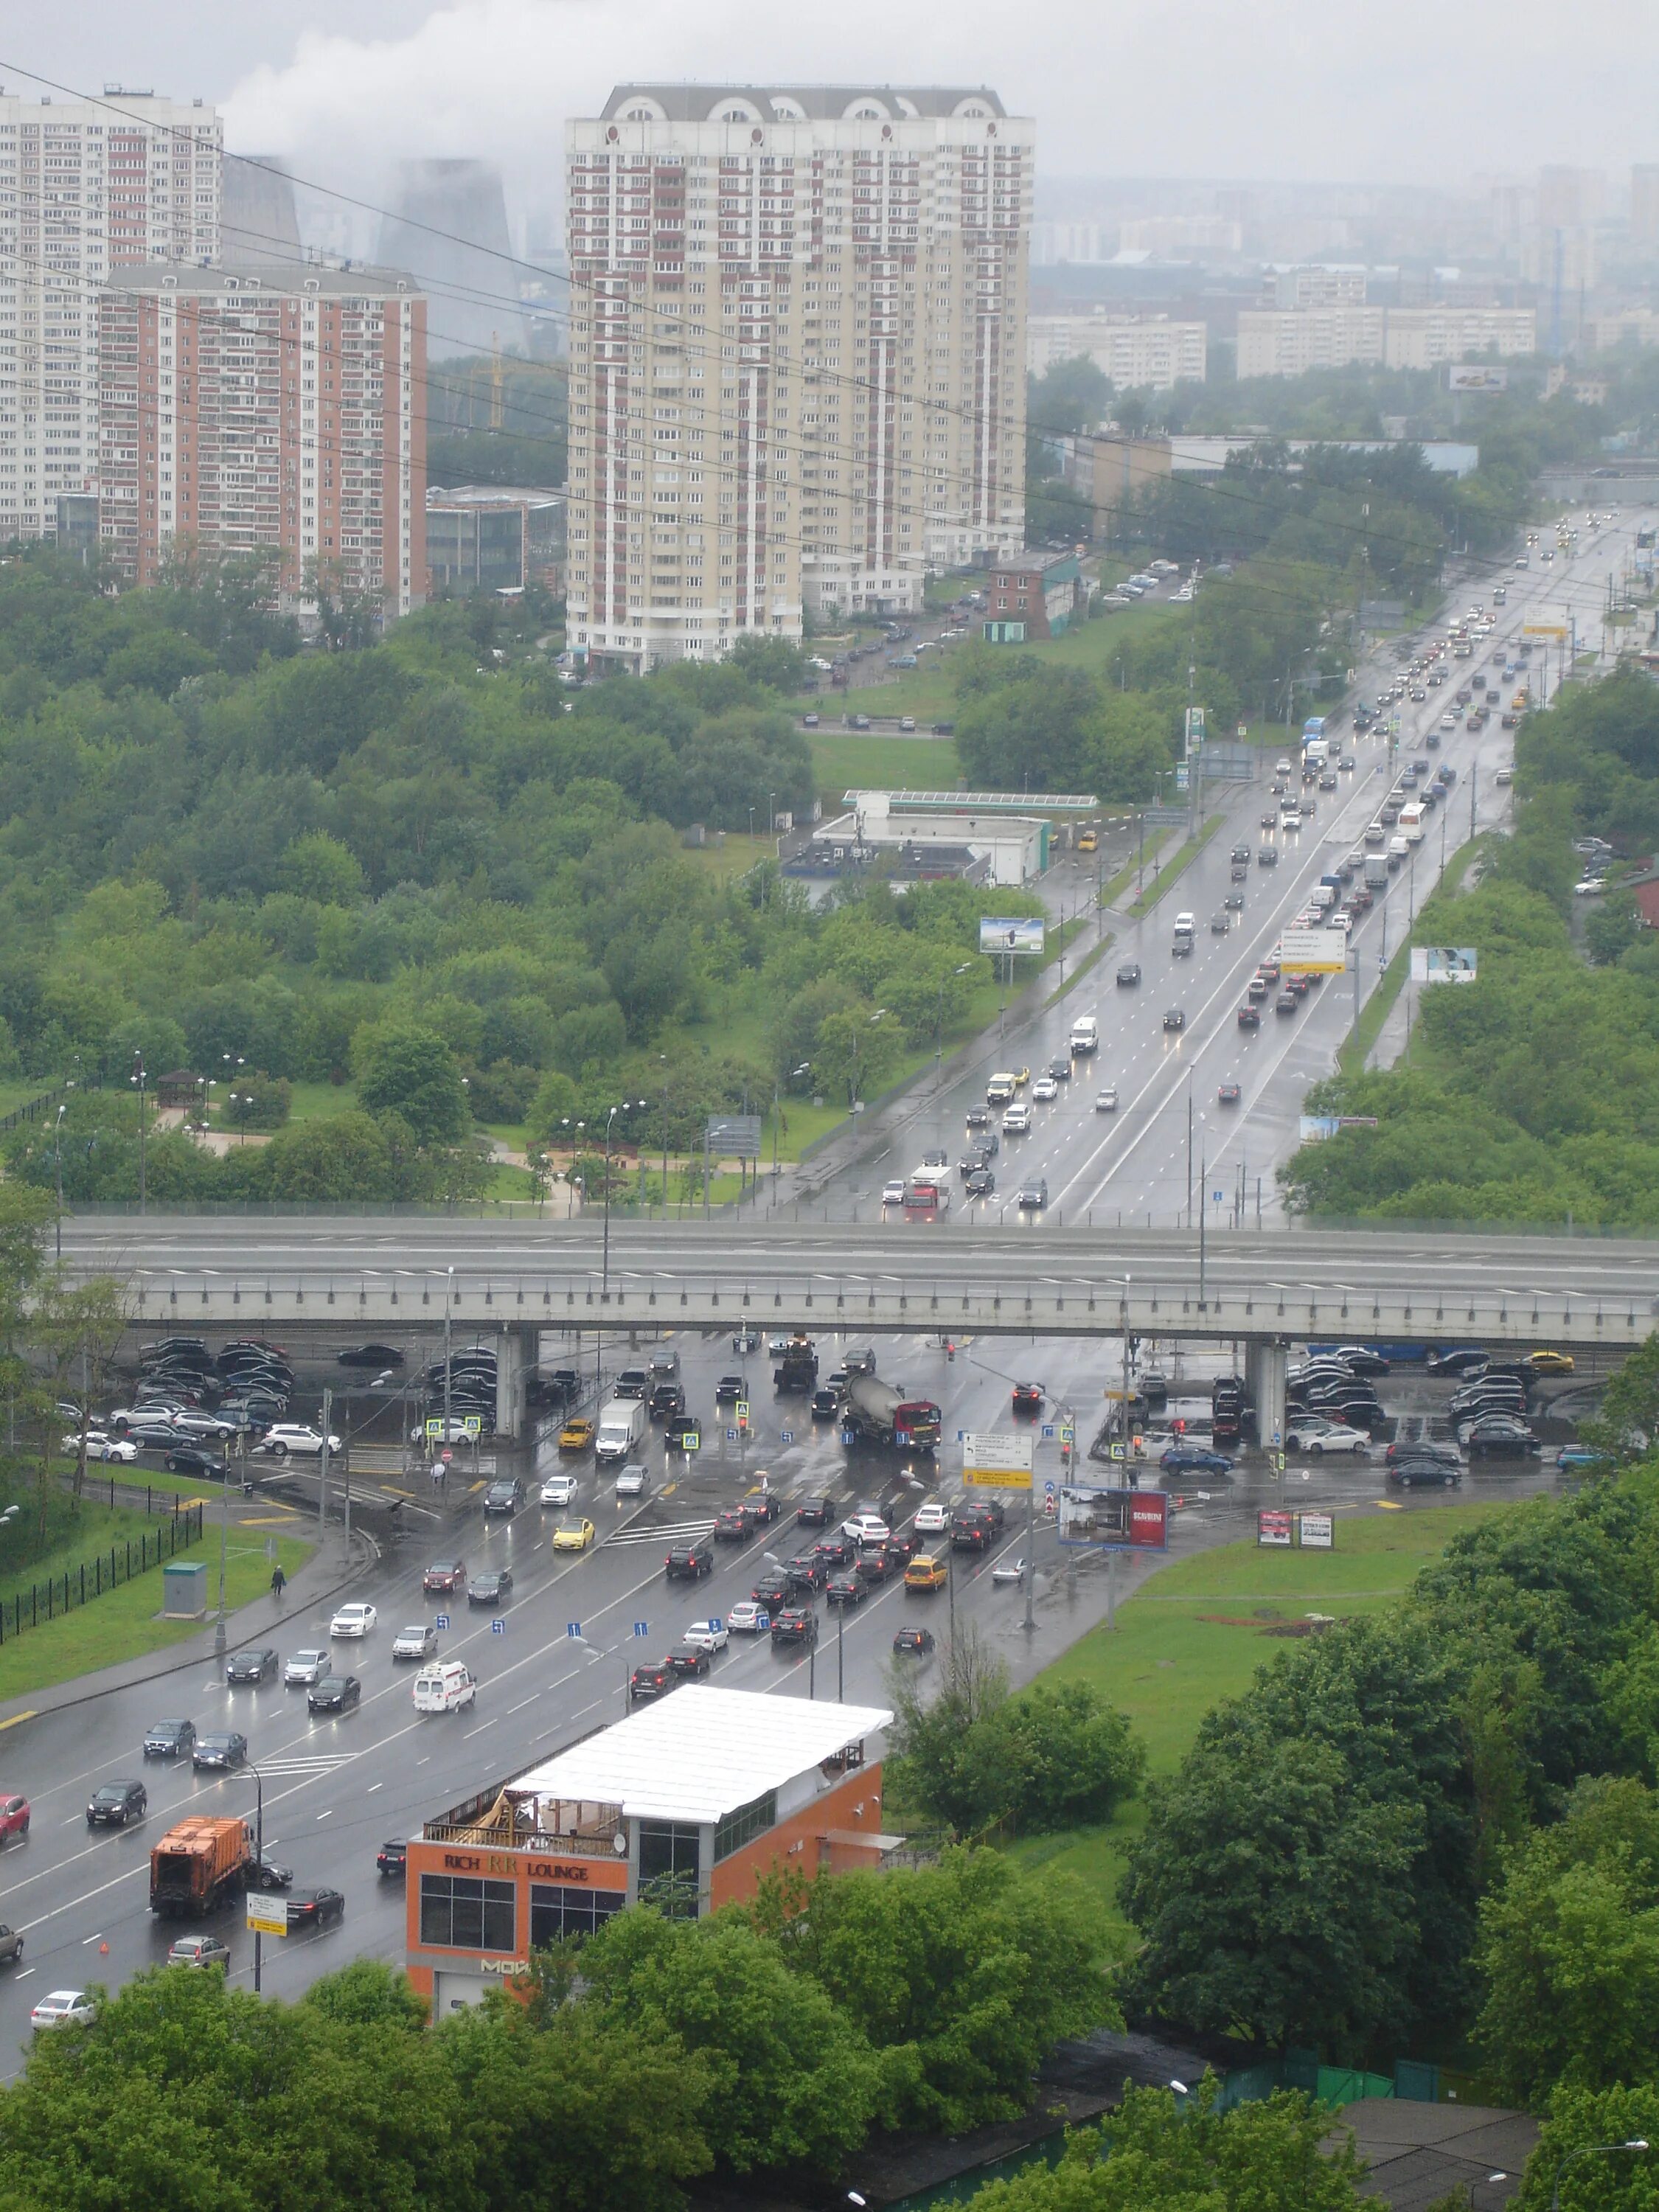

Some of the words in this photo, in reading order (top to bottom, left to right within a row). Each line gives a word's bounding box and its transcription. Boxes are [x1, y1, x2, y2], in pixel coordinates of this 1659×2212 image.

[445, 1854, 480, 1870] RICH
[487, 1854, 518, 1874] RR
[527, 1863, 588, 1881] LOUNGE
[481, 1959, 531, 1975] МОЙ
